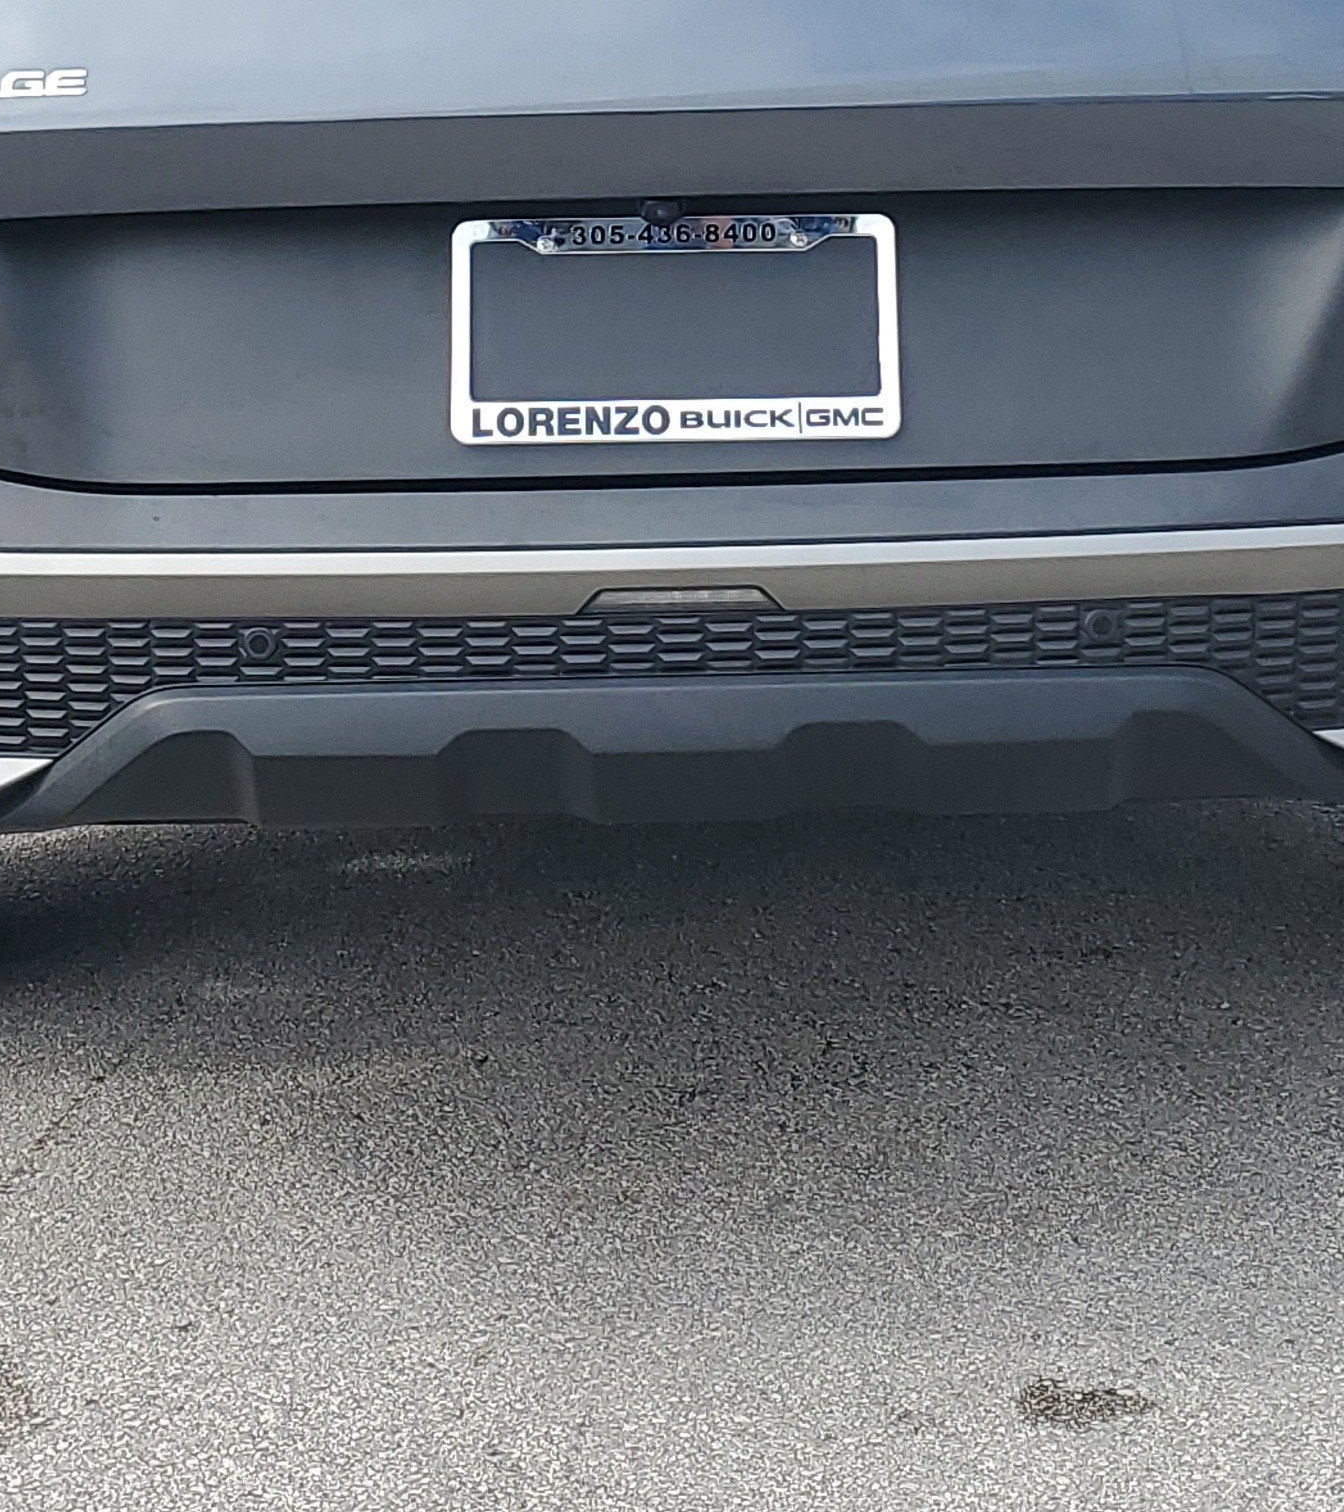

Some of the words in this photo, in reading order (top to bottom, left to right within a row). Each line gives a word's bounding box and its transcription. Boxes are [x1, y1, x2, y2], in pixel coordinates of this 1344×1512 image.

[571, 222, 776, 245] 305-436-8400
[471, 404, 670, 438] LORENZO
[680, 409, 794, 430] BUICK
[806, 407, 884, 428] GMC
